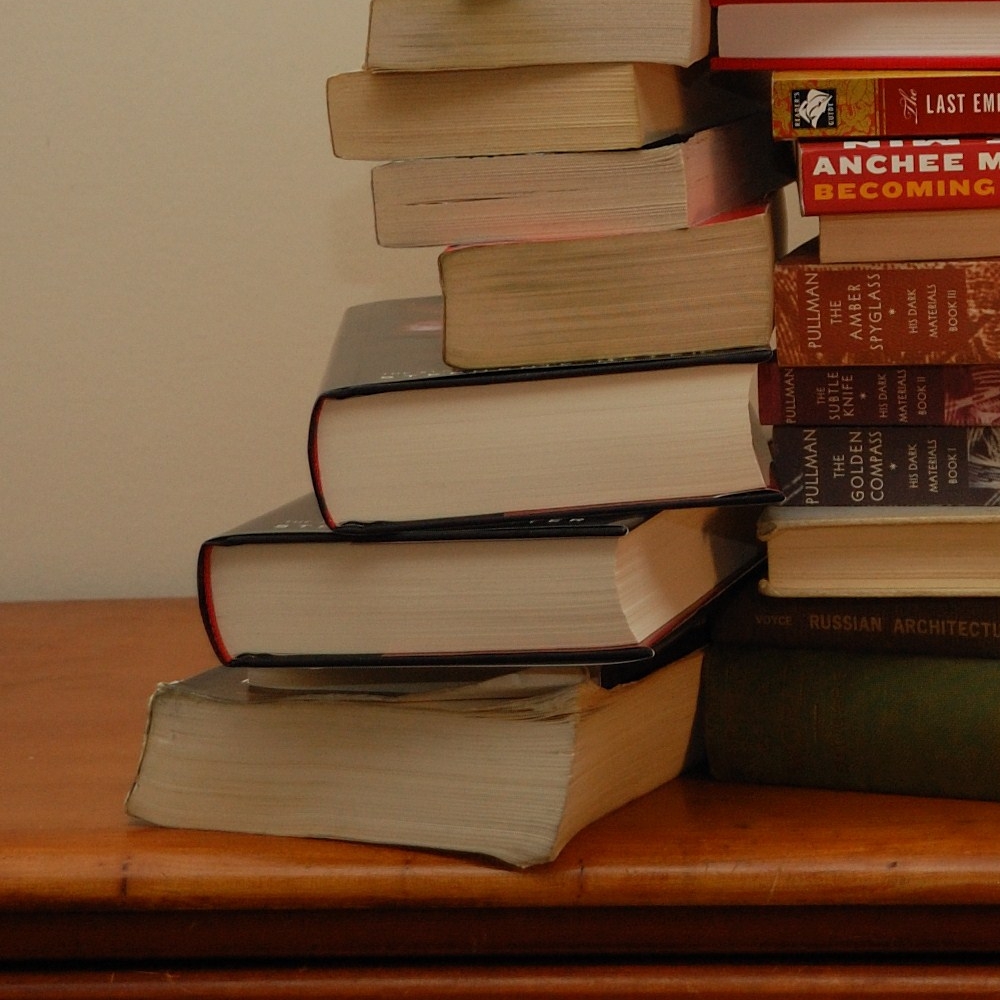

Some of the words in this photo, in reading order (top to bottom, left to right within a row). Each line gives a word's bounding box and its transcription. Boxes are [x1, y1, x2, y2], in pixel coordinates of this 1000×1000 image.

[898, 88, 918, 125] The
[926, 93, 966, 114] LAST
[812, 153, 964, 176] ANCHEE
[814, 178, 996, 201] BECOMING
[906, 288, 917, 316] DARK
[946, 289, 957, 299] III
[804, 272, 822, 349] PULLMAN
[829, 300, 843, 325] THE
[847, 284, 864, 341] AMBER
[866, 273, 884, 351] SPYGLASS
[908, 318, 919, 334] HIS
[926, 284, 938, 338] MATERIALS
[947, 301, 958, 332] BOOK
[784, 368, 797, 424] PULLMAN
[816, 386, 826, 404] THE
[827, 371, 841, 420] SUBTLE
[841, 374, 855, 417] KNIFE
[877, 373, 888, 401] DARK
[897, 368, 908, 424] MATERIALS
[917, 385, 927, 416] BOOK
[878, 403, 889, 418] HIS
[803, 429, 819, 505] PULLMAN
[833, 454, 846, 479] THE
[849, 431, 865, 502] GOLDEN
[868, 430, 884, 501] COMPASS
[906, 443, 918, 471] DARK
[927, 439, 939, 493] MATERIALS
[947, 454, 958, 484] BOOK
[908, 473, 919, 489] HIS
[808, 613, 883, 633] RUSSIAN
